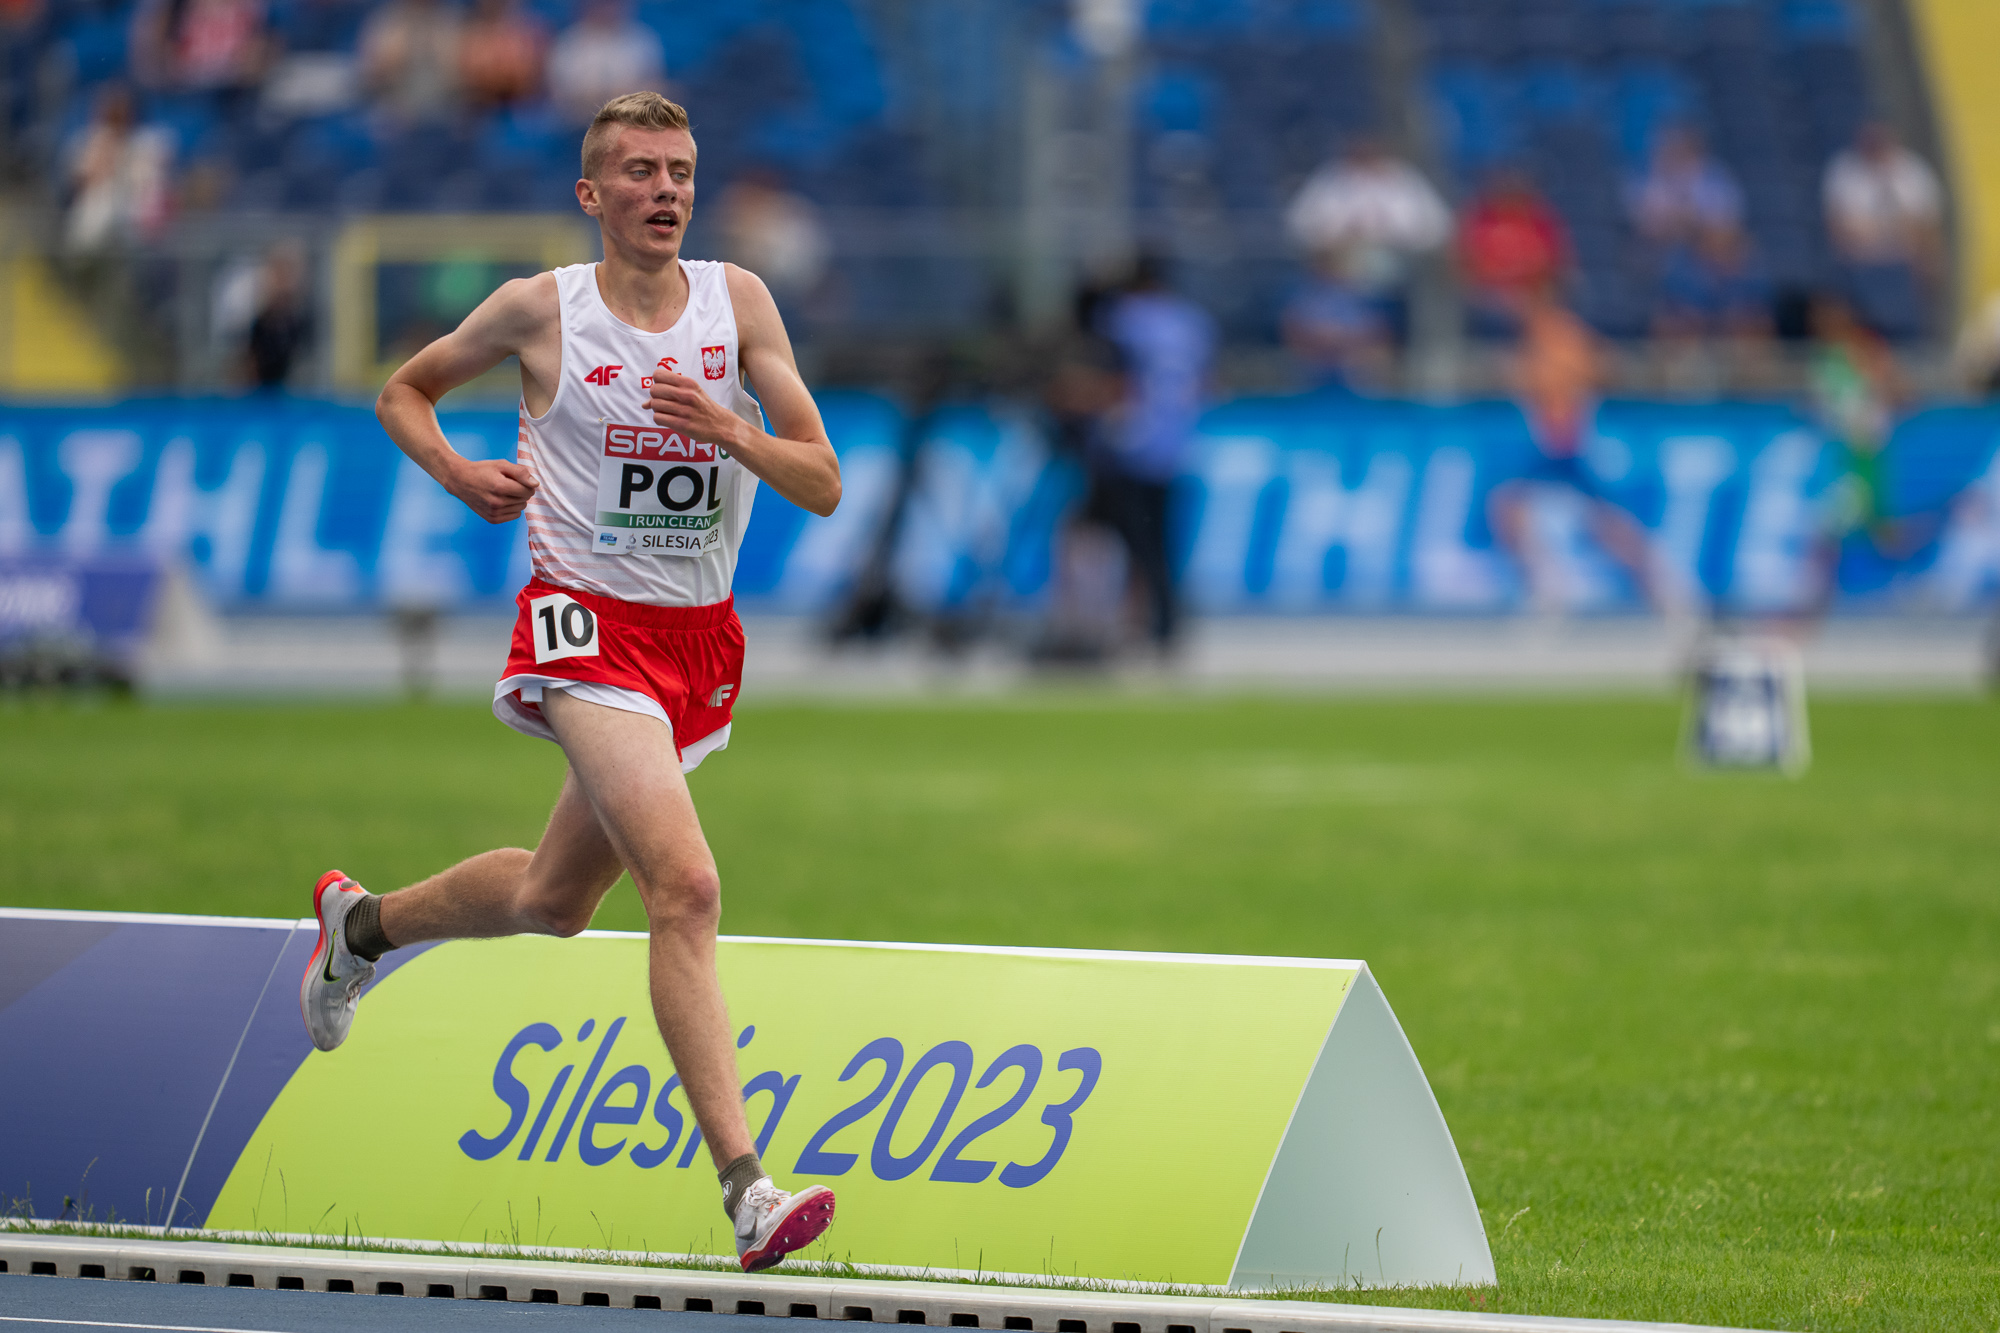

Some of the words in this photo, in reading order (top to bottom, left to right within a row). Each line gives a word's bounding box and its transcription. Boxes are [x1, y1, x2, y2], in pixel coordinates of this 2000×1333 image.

[584, 365, 623, 386] 4F
[608, 429, 713, 458] SPAR
[619, 463, 721, 512] POL
[628, 515, 633, 527] I
[636, 515, 666, 527] RUN
[668, 516, 711, 529] CLEAN
[642, 534, 701, 550] SILESIA
[538, 602, 594, 651] 10
[792, 1037, 1101, 1188] 2023
